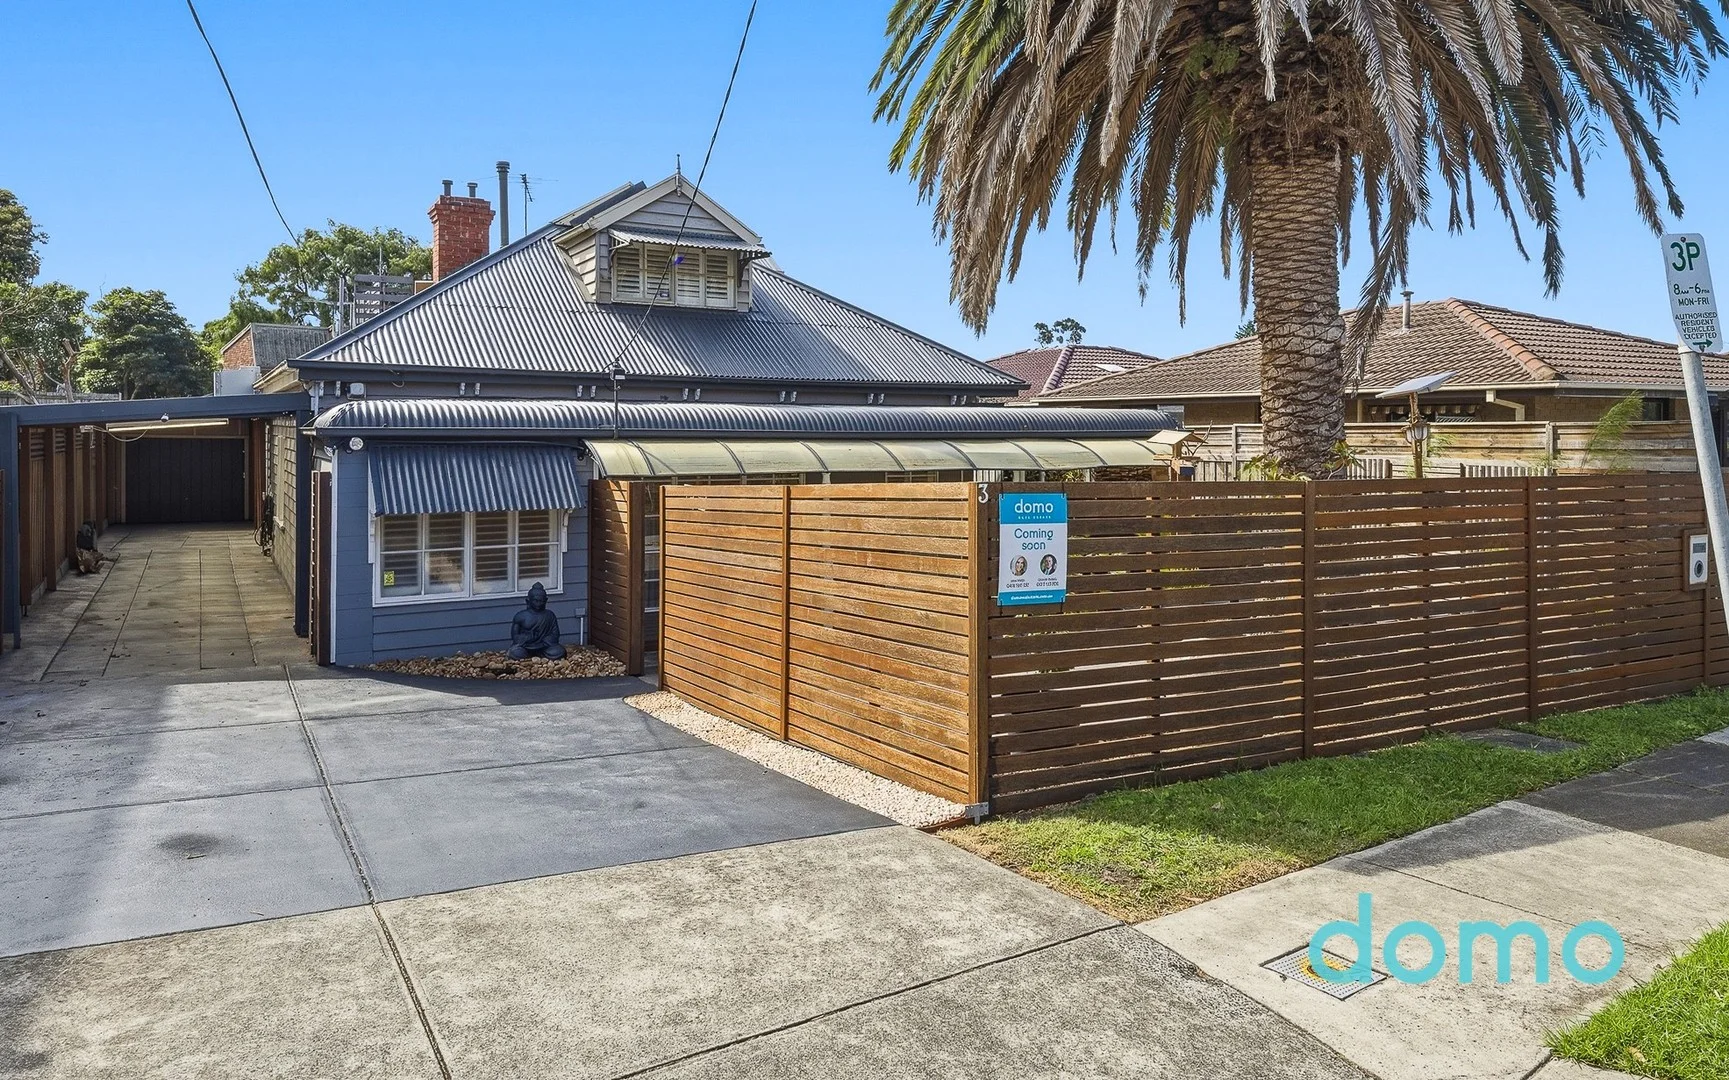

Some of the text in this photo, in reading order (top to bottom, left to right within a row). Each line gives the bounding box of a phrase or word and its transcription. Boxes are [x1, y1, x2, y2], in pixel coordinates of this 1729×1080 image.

[1670, 241, 1700, 271] 3P
[1678, 297, 1710, 306] MON-FRI
[1675, 311, 1717, 320] AUTHORISED
[1681, 319, 1714, 327] RESIDENT
[978, 483, 989, 504] 3
[1014, 498, 1054, 514] domo
[1014, 527, 1054, 541] Coming
[1021, 541, 1046, 551] soon
